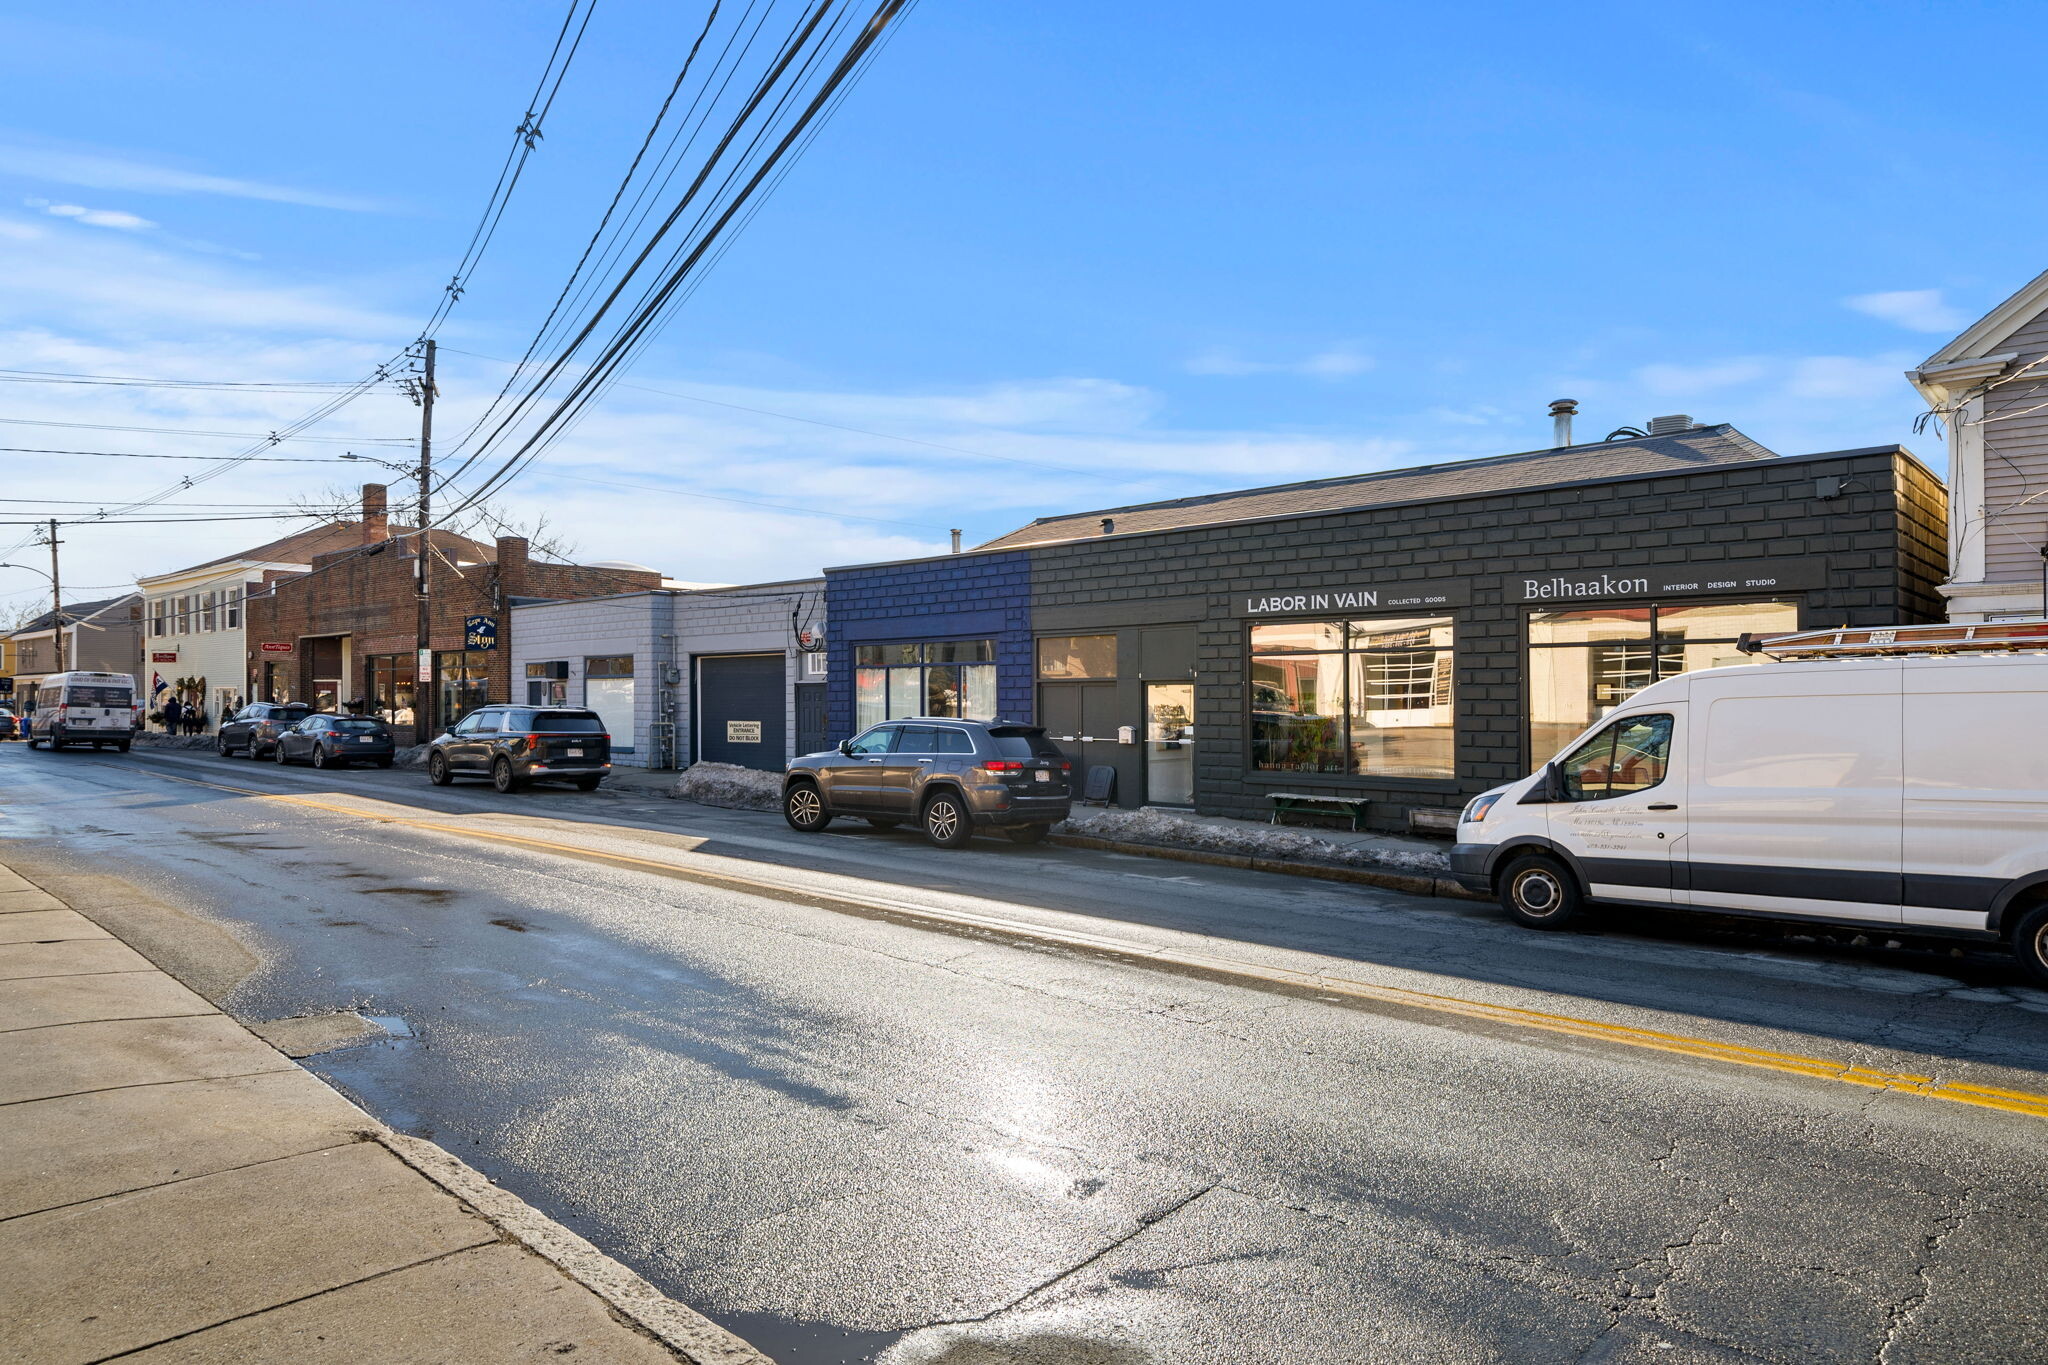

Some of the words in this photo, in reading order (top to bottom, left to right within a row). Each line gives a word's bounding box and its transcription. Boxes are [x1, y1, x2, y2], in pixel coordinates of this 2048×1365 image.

[1523, 575, 1648, 599] Belhaakon
[1663, 583, 1699, 591] INTERIOR
[1707, 581, 1737, 589] DESIGN
[1745, 579, 1776, 587] STUDIO
[1247, 596, 1306, 613] LABOR
[1310, 594, 1329, 609] IN
[1333, 591, 1378, 608] VAIN
[466, 618, 481, 627] Cape
[467, 632, 495, 649] Sign
